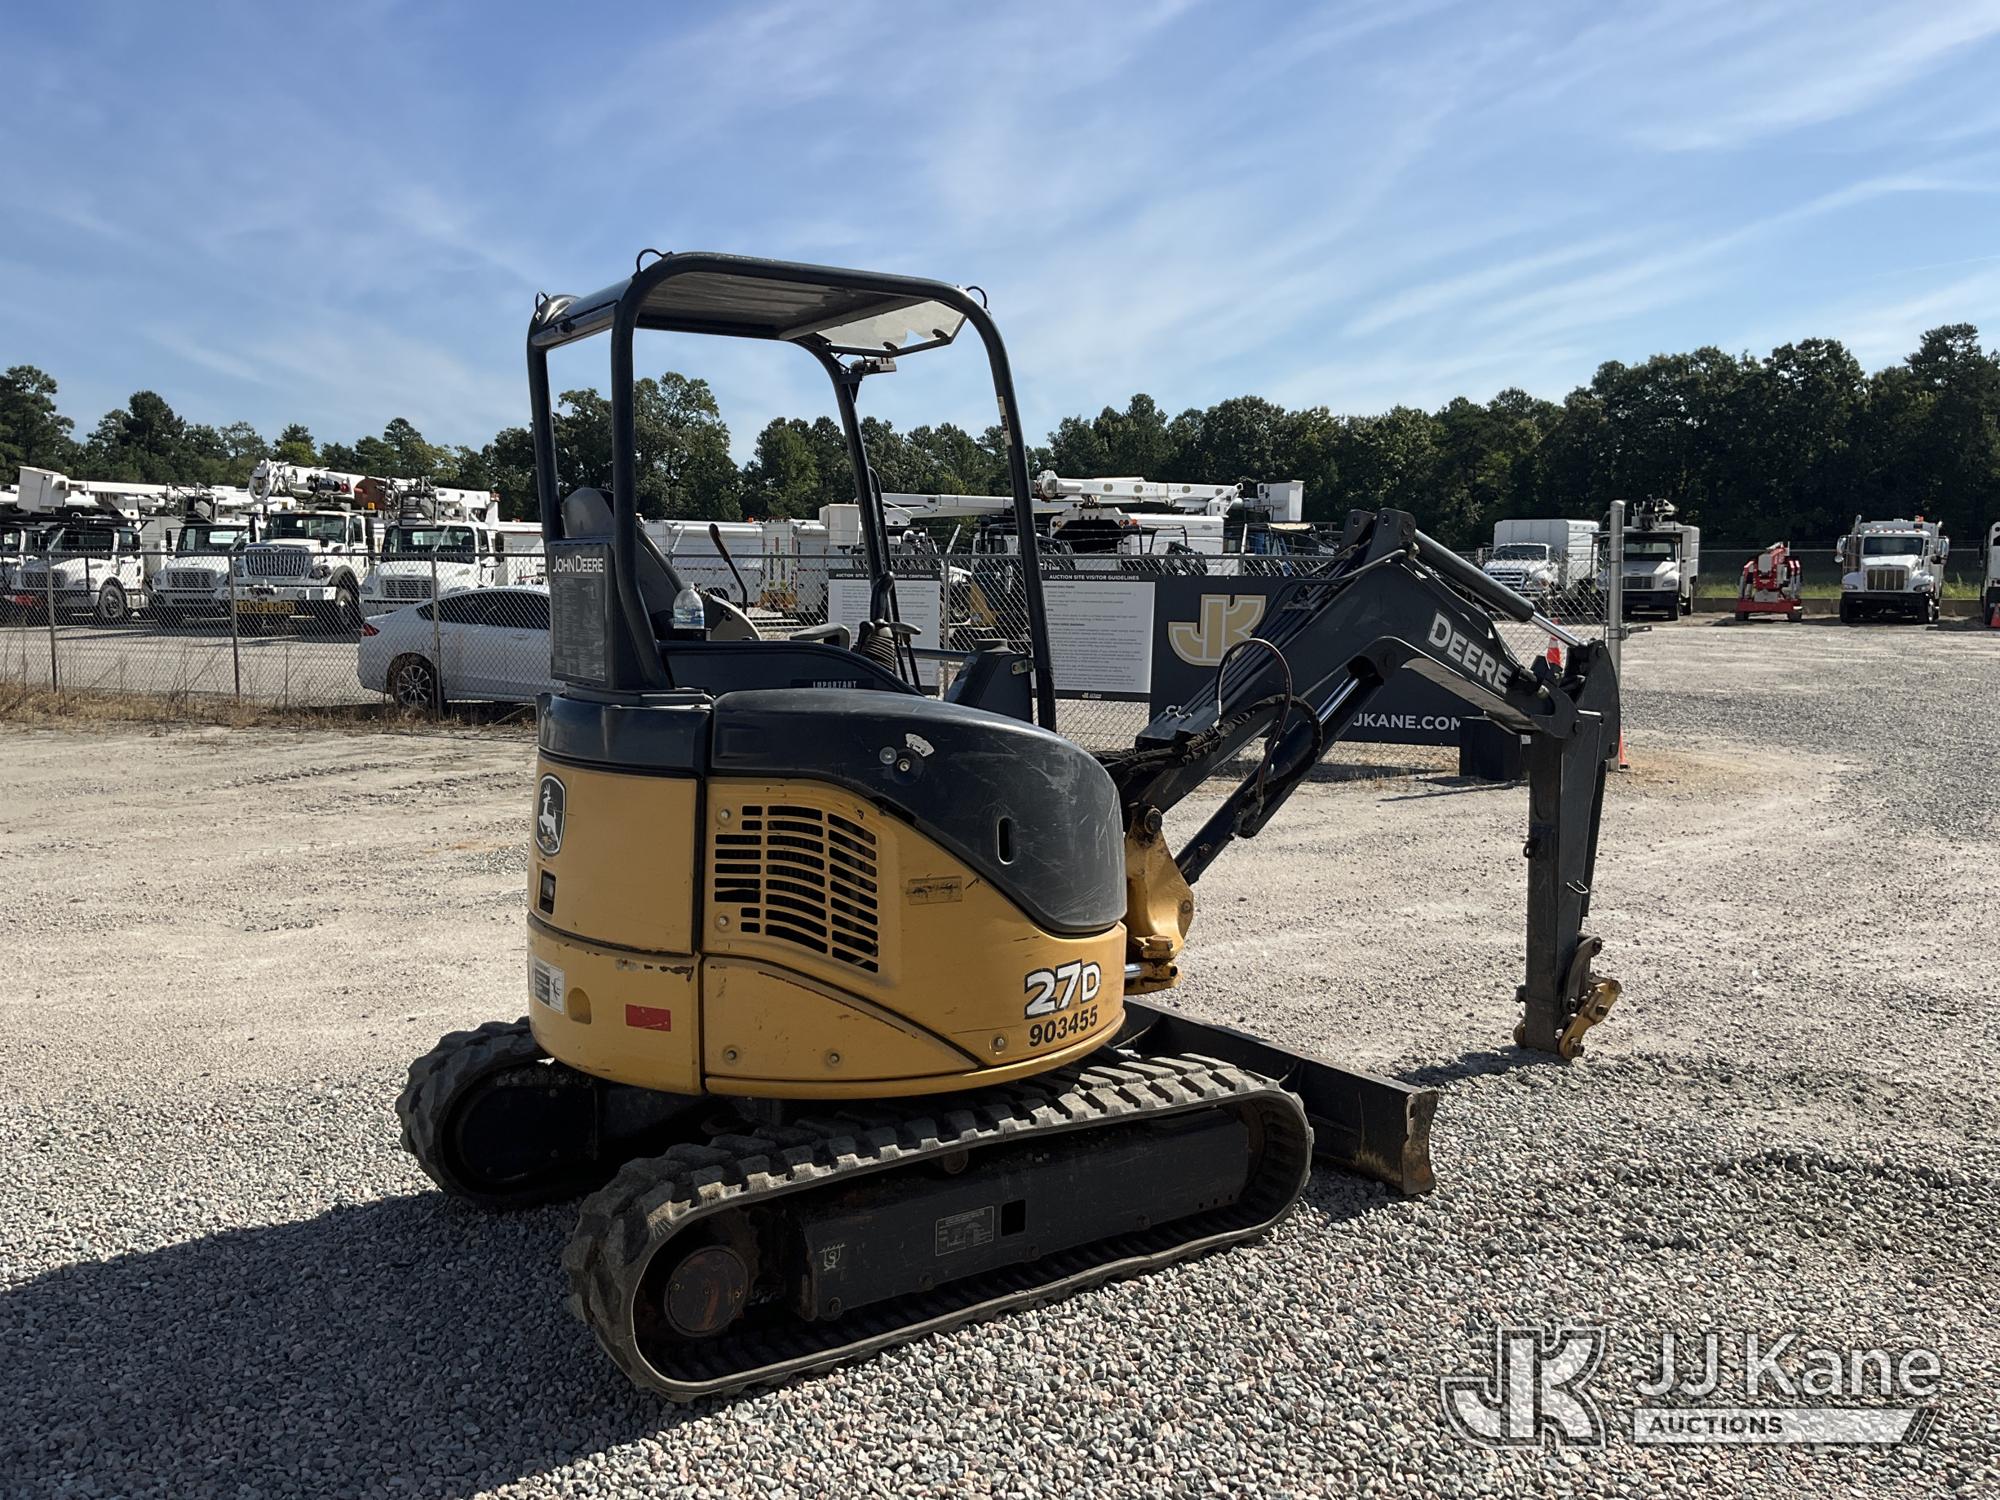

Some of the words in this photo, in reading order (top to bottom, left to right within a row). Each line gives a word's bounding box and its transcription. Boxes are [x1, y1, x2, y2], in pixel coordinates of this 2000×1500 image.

[552, 554, 575, 573] JOHN
[575, 554, 604, 573] DEERE
[1428, 612, 1512, 694] DEERE
[812, 680, 857, 689] IMPORTANT
[1024, 959, 1102, 1020] 27D
[1029, 1004, 1098, 1047] 903455
